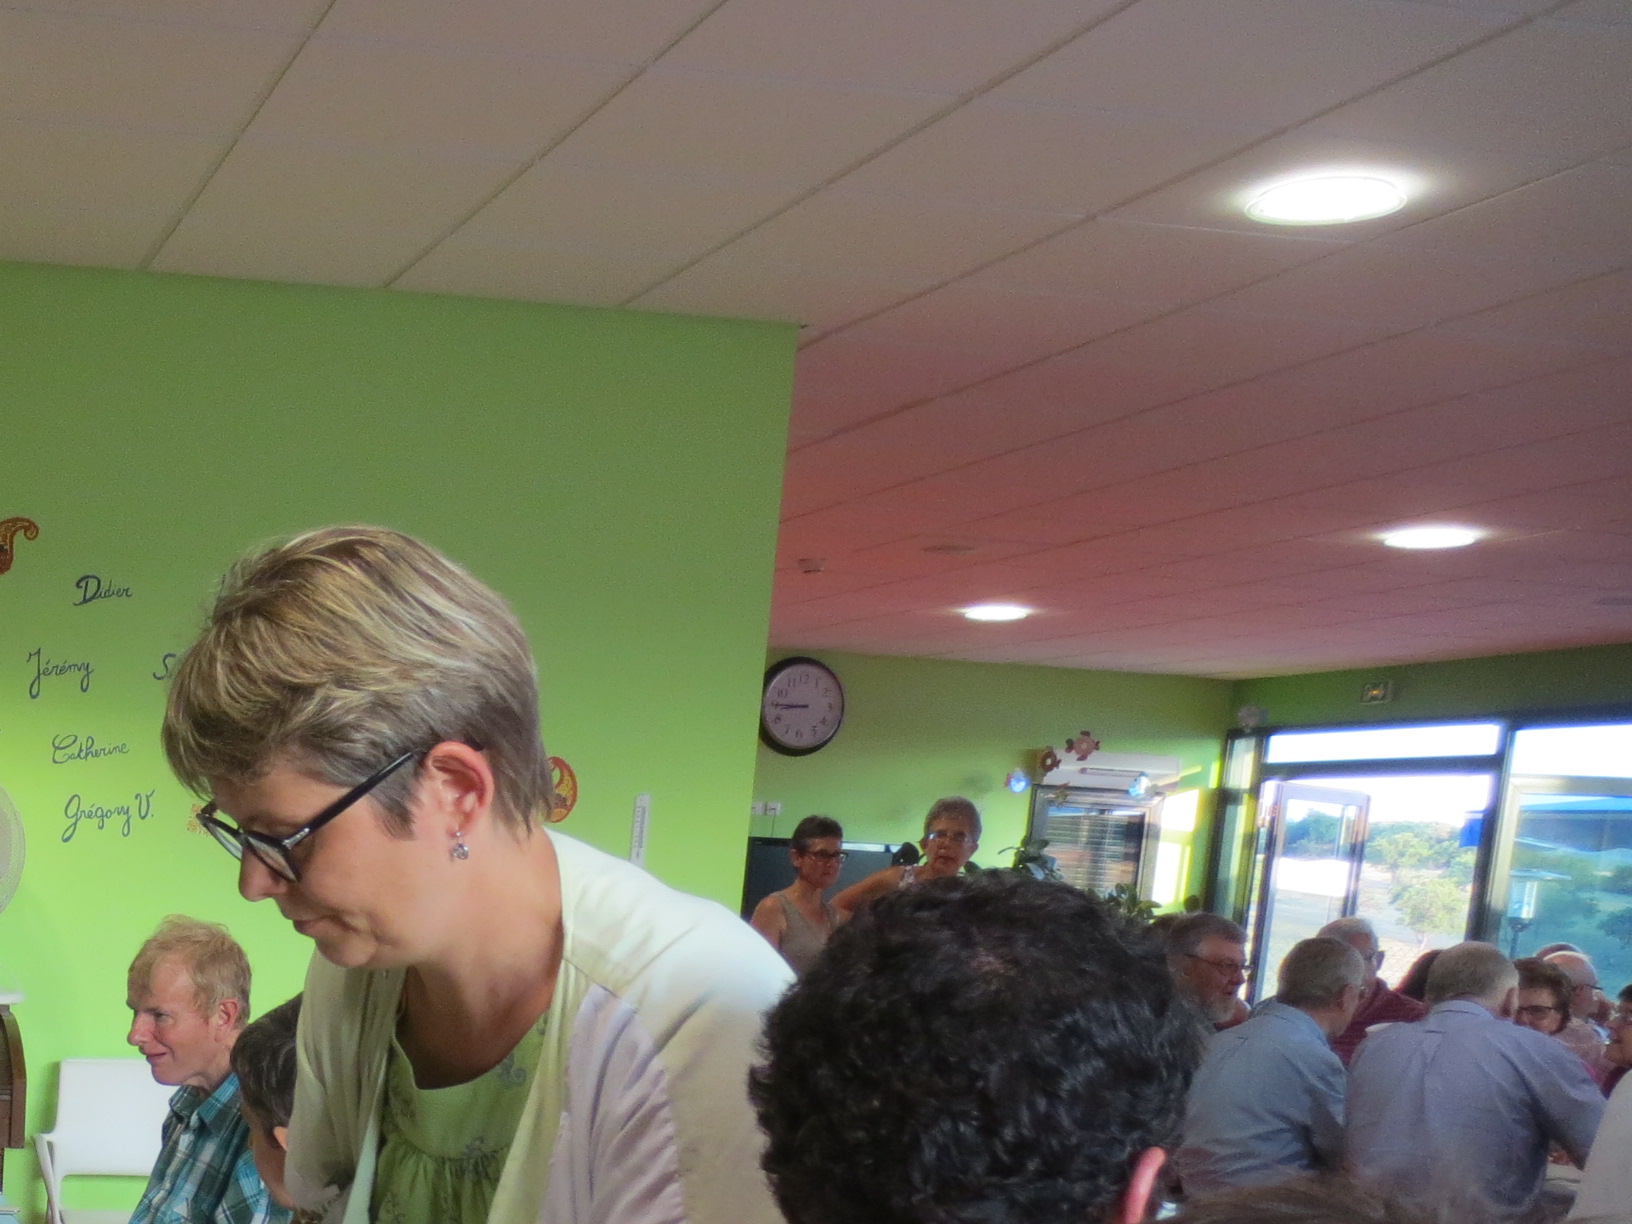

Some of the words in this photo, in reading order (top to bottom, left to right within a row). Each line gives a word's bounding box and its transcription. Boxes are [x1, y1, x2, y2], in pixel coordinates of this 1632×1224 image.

[73, 574, 133, 606] Didier
[27, 648, 94, 700] Jérémy
[52, 734, 130, 764] Catherine
[61, 794, 131, 843] Grégory
